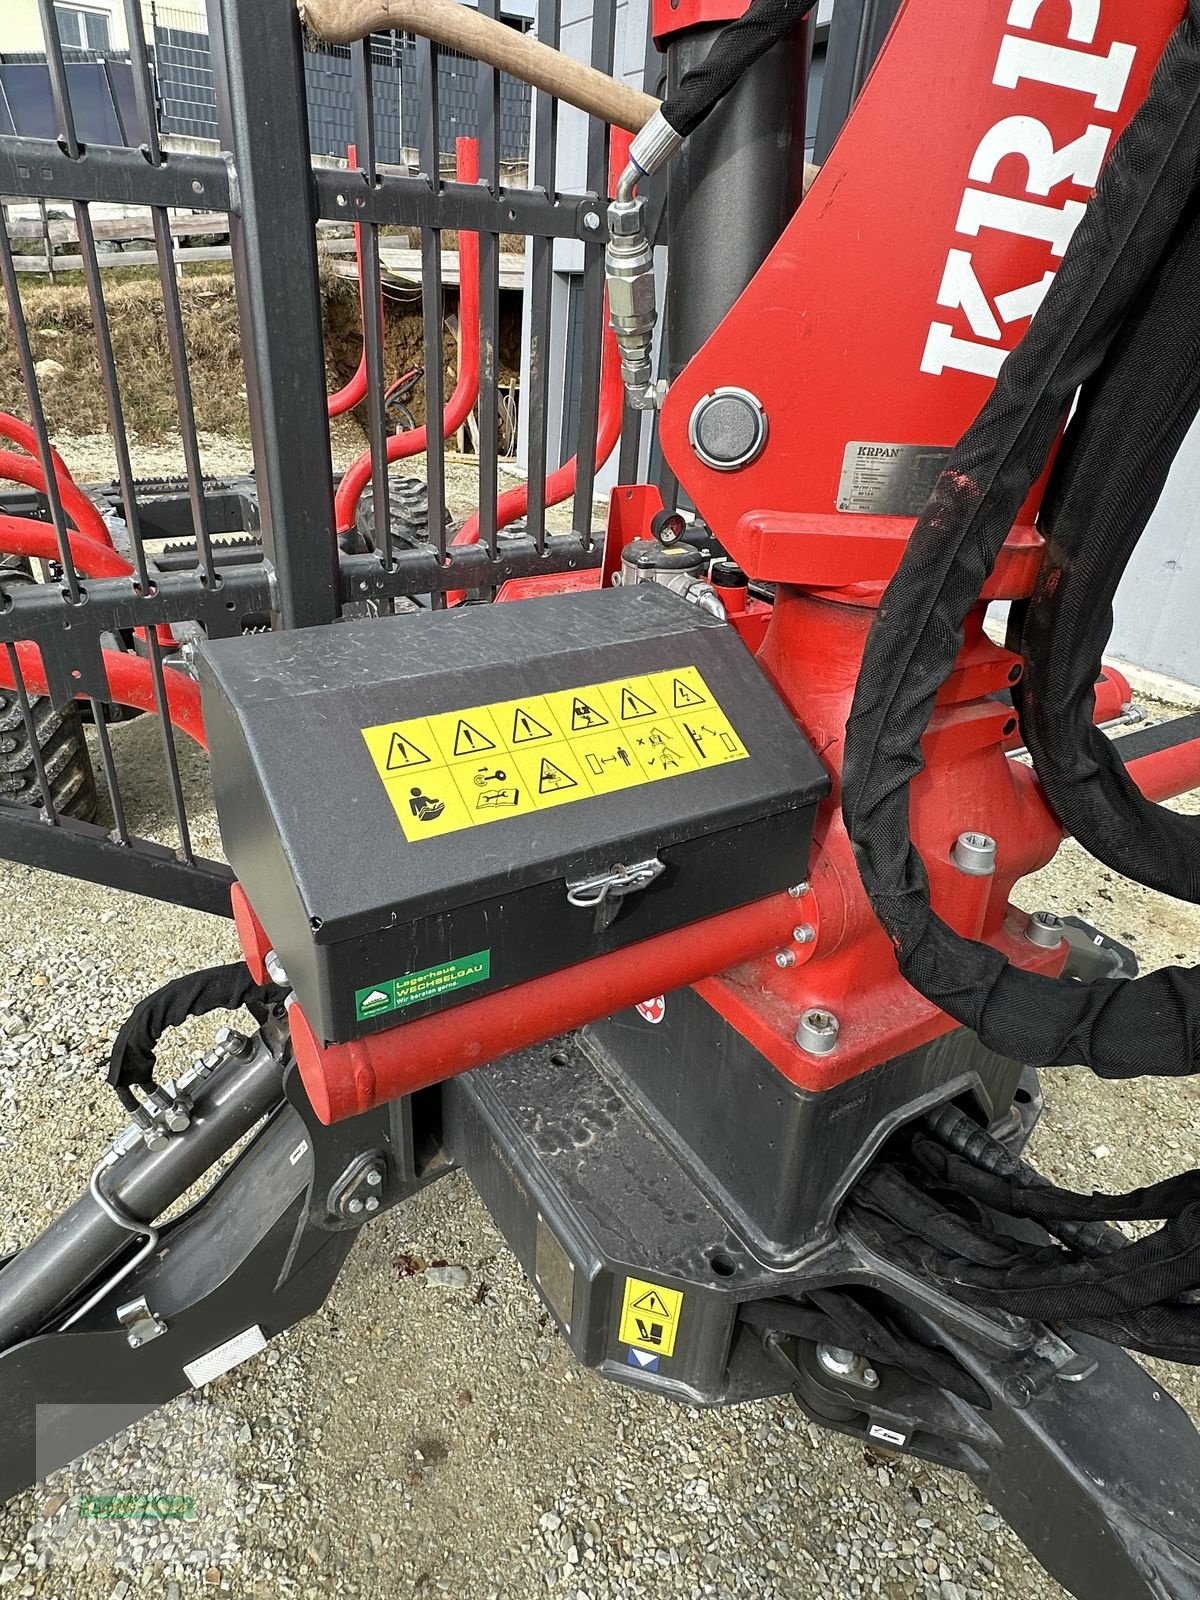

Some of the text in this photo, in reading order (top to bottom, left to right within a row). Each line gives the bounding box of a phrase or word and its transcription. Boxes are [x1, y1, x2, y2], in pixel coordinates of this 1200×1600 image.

[857, 446, 899, 457] KRPAN
[396, 966, 456, 989] Lagerhaus
[396, 965, 483, 997] WECHSELGAU
[396, 996, 409, 1005] Wir
[410, 987, 436, 1000] beraten
